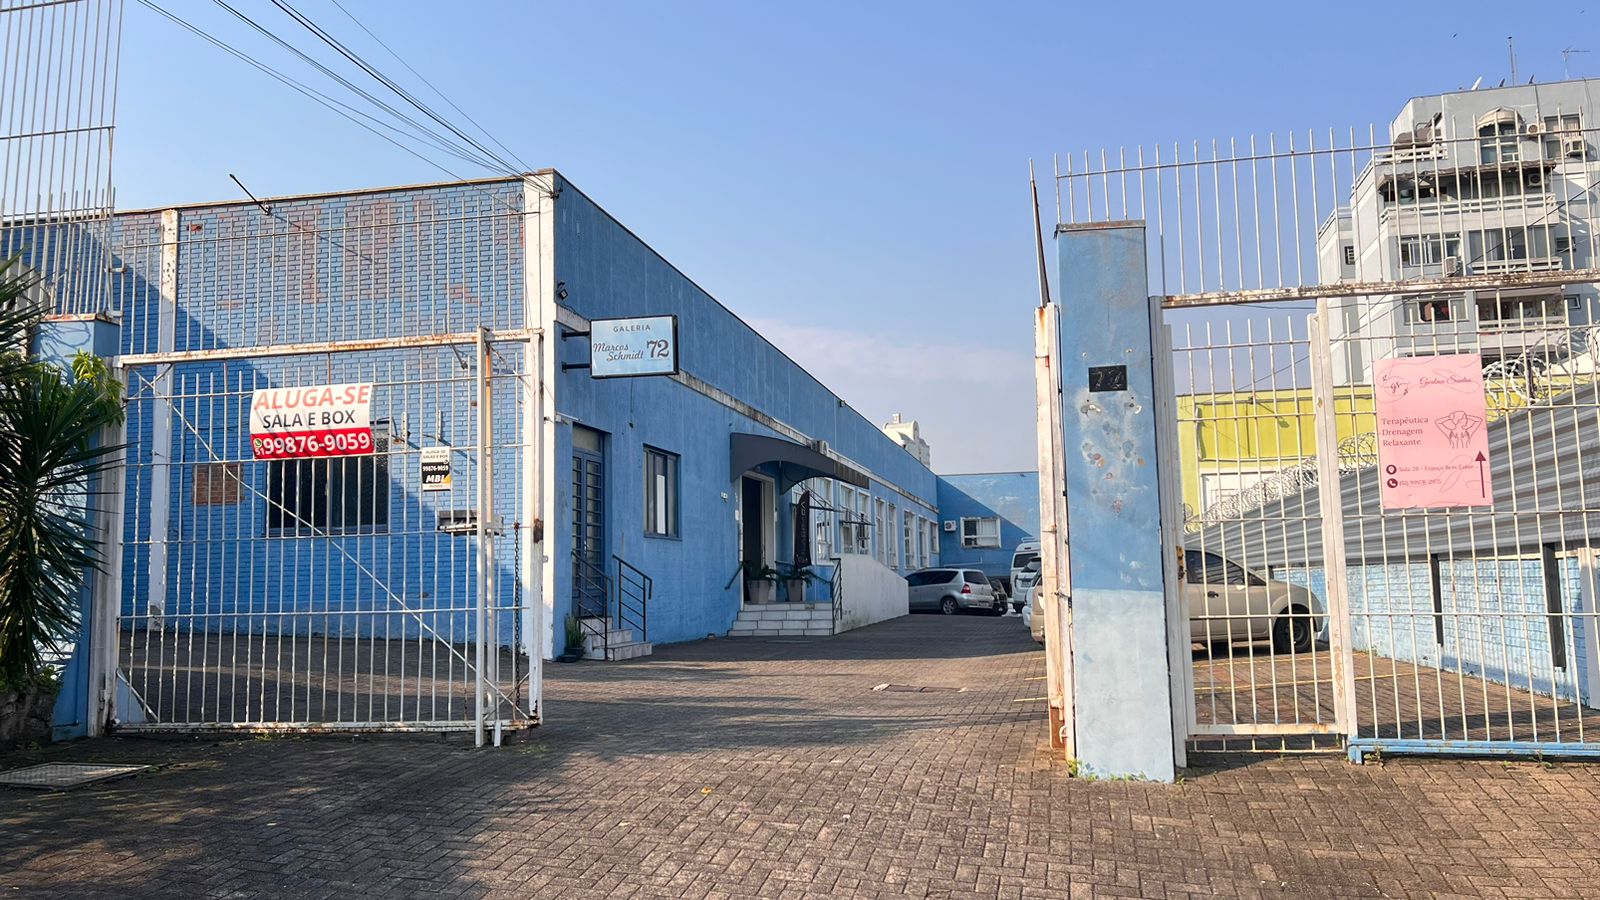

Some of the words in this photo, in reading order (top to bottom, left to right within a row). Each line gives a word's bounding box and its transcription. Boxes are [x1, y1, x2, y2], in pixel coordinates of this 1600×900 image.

[613, 324, 651, 333] GALERIA
[593, 342, 629, 352] Marcos
[646, 339, 670, 358] 72
[606, 350, 644, 362] Schmidt
[254, 385, 370, 410] ALUGA-SE
[262, 413, 303, 428] SALA
[308, 412, 316, 425] E
[321, 409, 355, 424] BOX
[1382, 417, 1429, 426] Terapêutica
[1382, 428, 1423, 437] Drenagem
[263, 432, 370, 454] 99876-9059
